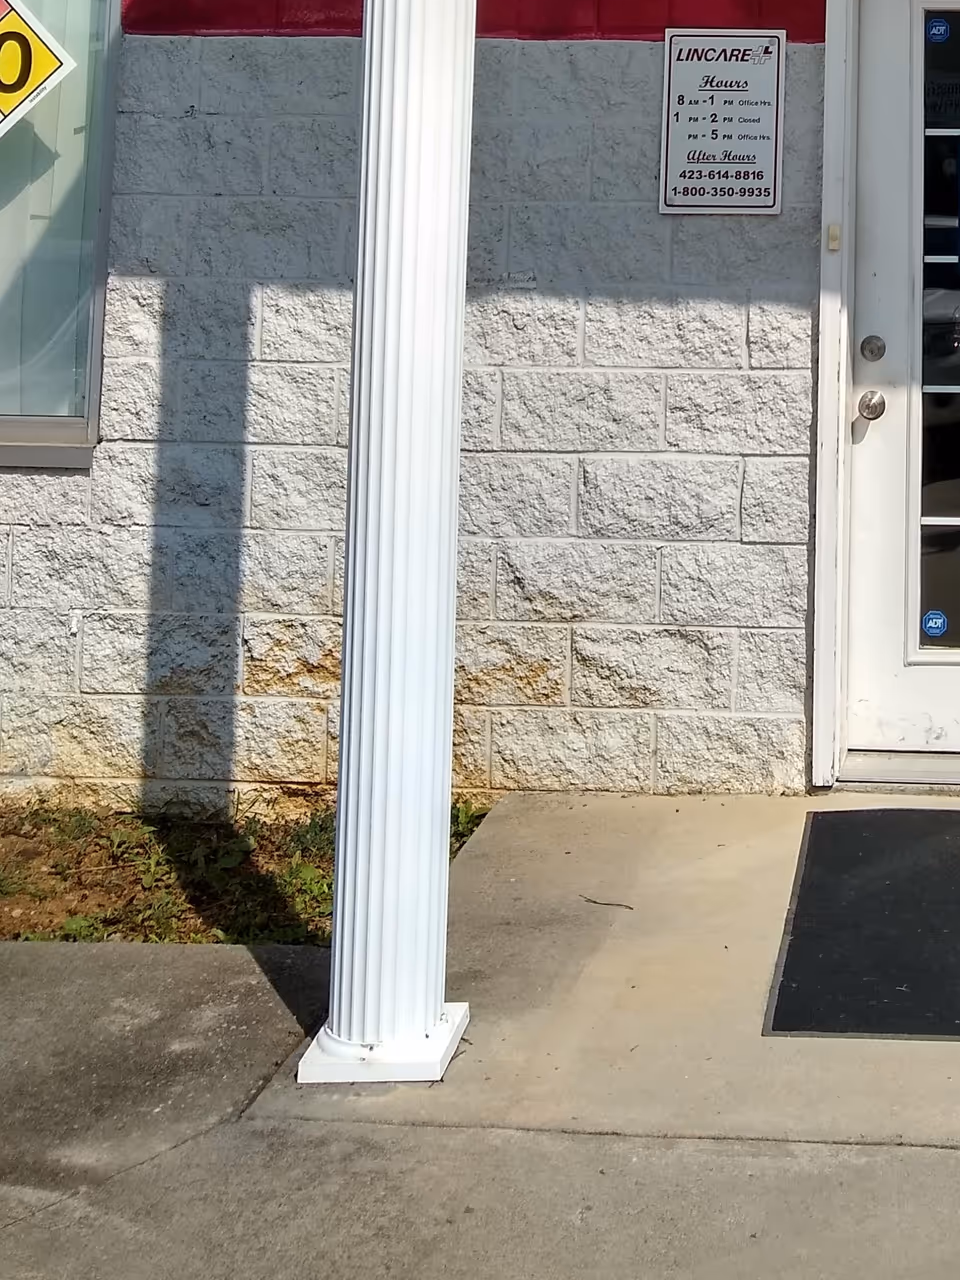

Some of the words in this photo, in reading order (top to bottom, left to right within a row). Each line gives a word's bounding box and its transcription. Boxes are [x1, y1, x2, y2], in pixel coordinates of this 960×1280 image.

[930, 26, 946, 35] ADT
[676, 48, 753, 62] LINCARE
[0, 31, 32, 94] 0
[699, 75, 749, 90] Hours
[677, 95, 685, 106] 8
[708, 95, 715, 106] 1
[673, 112, 680, 122] 1
[710, 113, 718, 123] 2
[711, 129, 718, 140] 5
[686, 150, 717, 163] After
[719, 150, 757, 162] Hours
[679, 170, 764, 180] 423-614-8816
[671, 187, 771, 197] 1-800-350-9935
[927, 619, 943, 628] ADT
